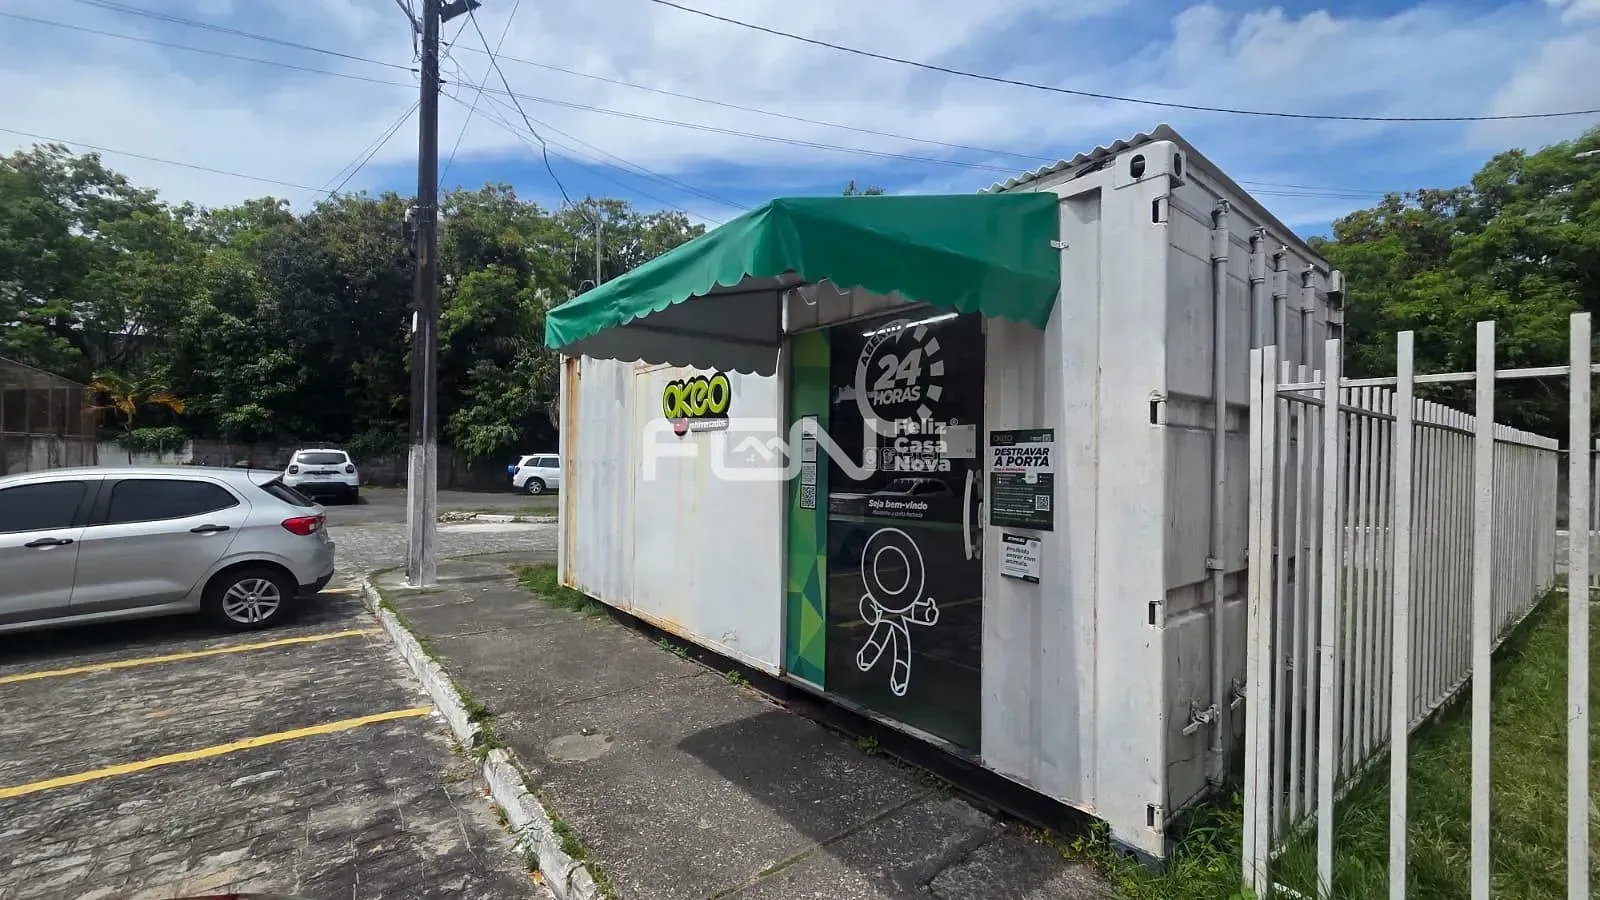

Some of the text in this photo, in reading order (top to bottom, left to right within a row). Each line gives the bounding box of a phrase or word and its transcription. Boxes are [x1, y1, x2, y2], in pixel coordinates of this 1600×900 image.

[874, 348, 924, 391] 24
[874, 386, 921, 406] HORAS
[994, 447, 1050, 456] DESTRAVAR
[994, 456, 1049, 467] A PORTA
[868, 499, 928, 510] Seja bem-vindo
